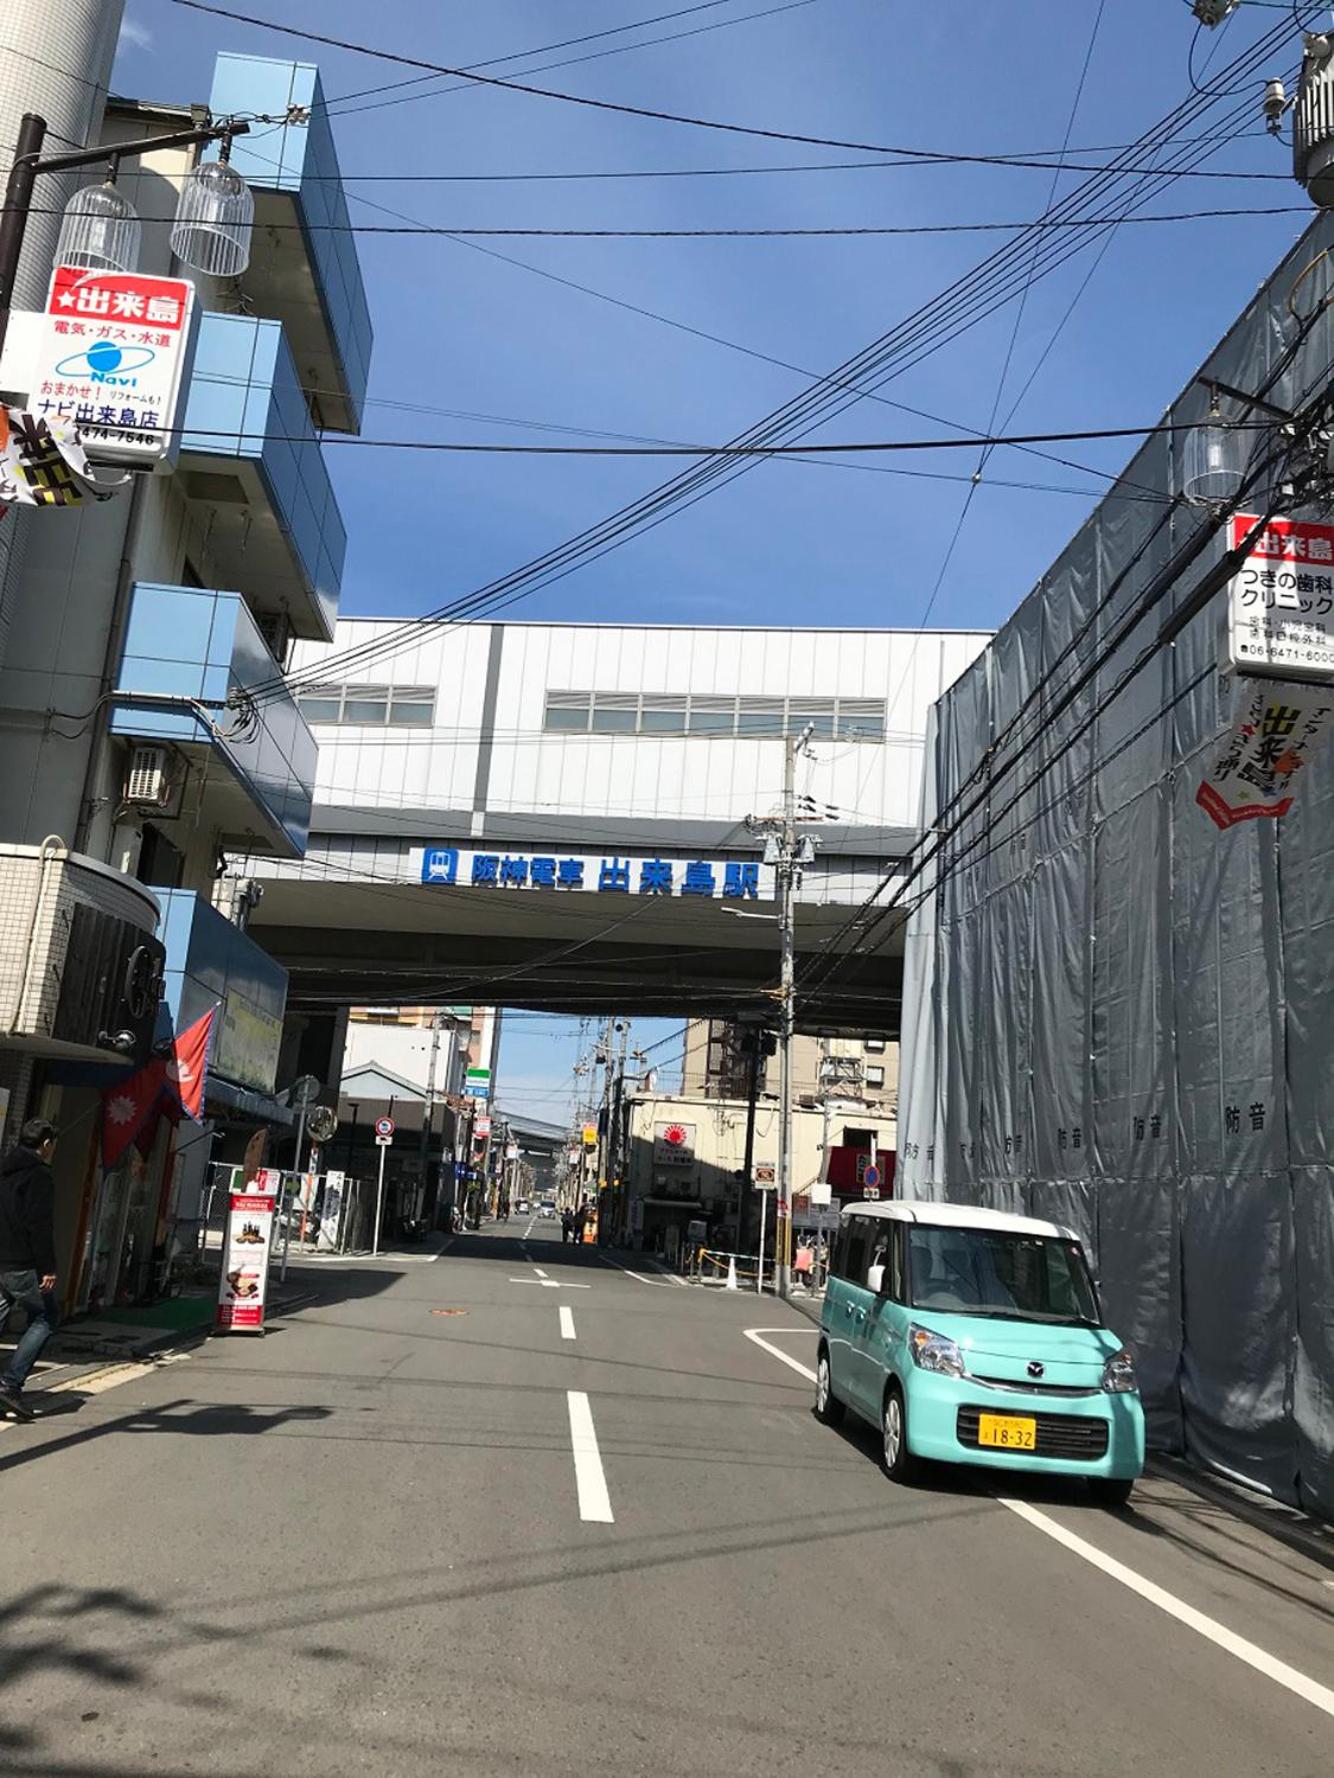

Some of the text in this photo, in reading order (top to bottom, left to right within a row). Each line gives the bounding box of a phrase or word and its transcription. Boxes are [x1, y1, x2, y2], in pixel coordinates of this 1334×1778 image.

[77, 287, 179, 323] 出来島
[54, 320, 171, 347] 電気・ガス・水道
[91, 371, 137, 387] Navi
[38, 398, 159, 429] ナビ出来島店
[1254, 532, 1332, 561] 出来島
[1241, 569, 1333, 595] つきの歯科
[1241, 590, 1333, 615] クリニック
[472, 855, 759, 897] 阪神電車 出来島駅
[1225, 1102, 1266, 1135] 防音
[993, 1428, 1032, 1447] 18-32
